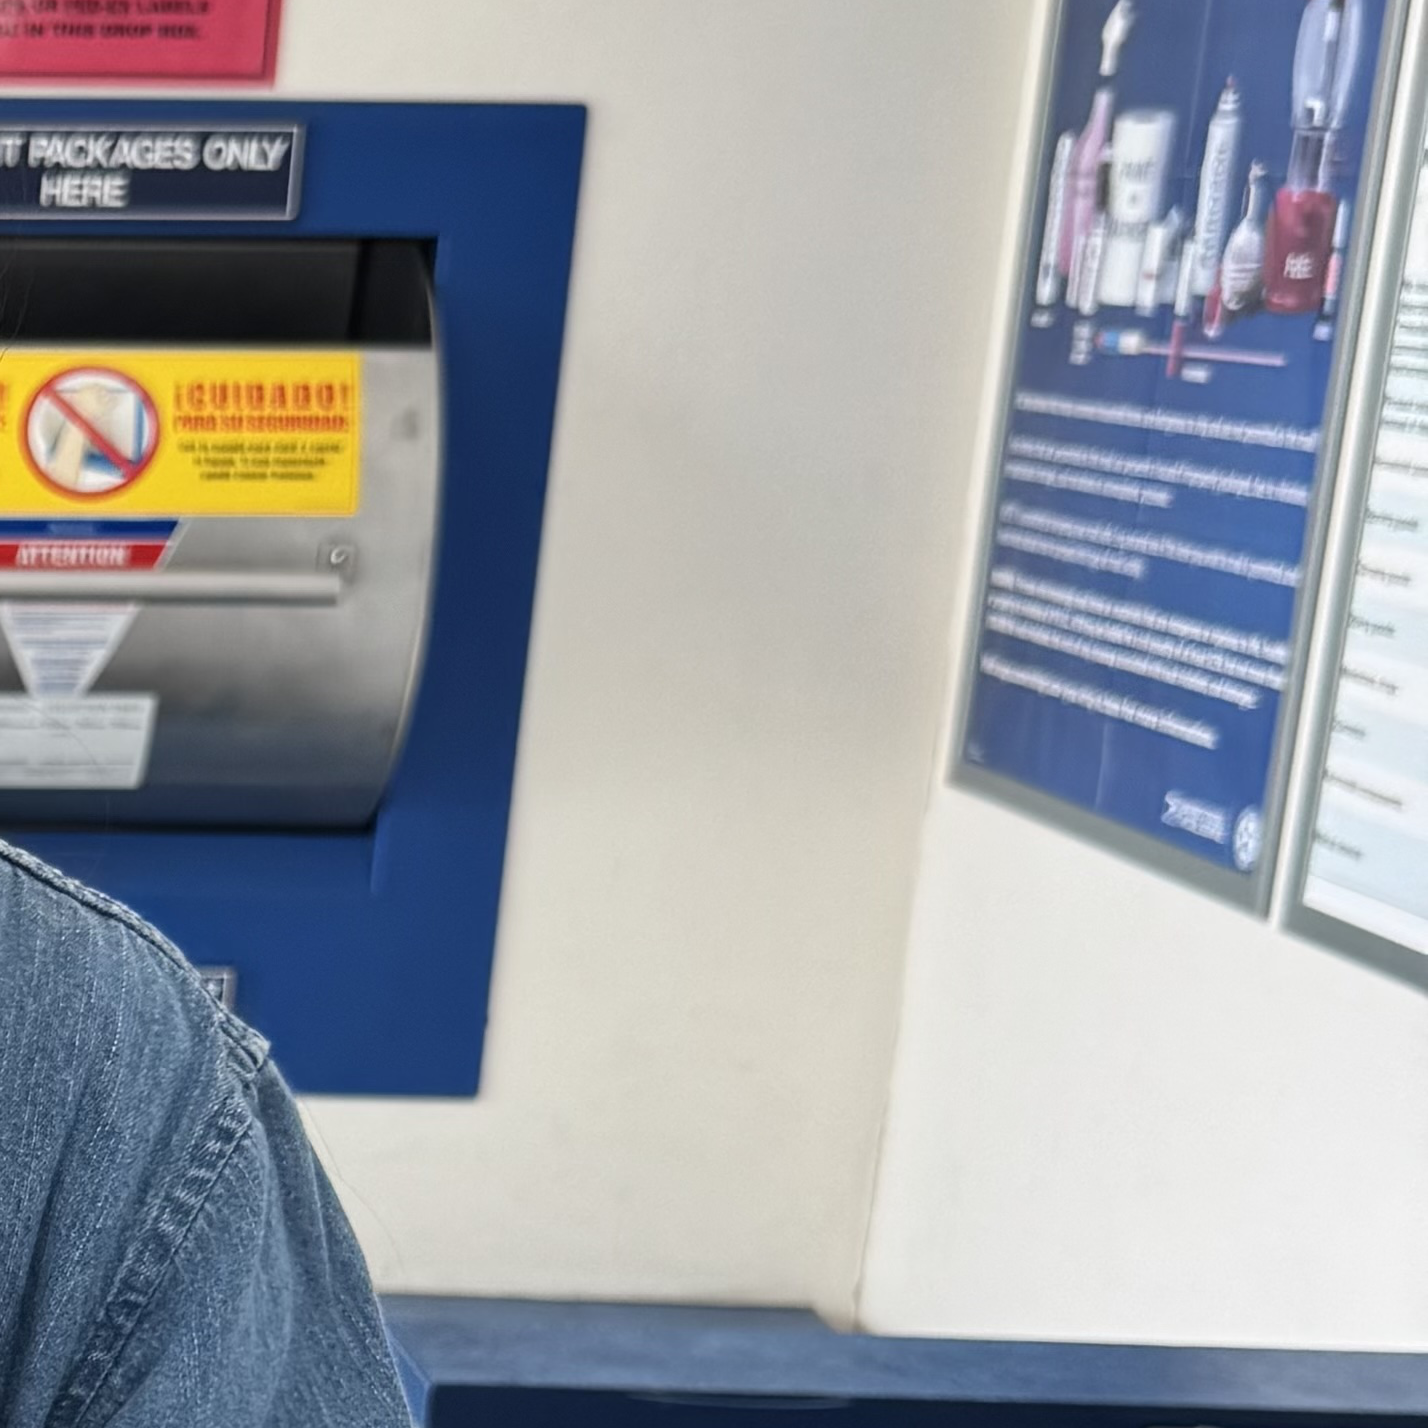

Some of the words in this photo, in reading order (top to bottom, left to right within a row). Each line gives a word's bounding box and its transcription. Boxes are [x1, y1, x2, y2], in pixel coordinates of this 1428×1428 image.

[27, 133, 200, 170] PACKAGES
[202, 134, 291, 171] ONLY
[38, 172, 131, 209] HERE
[17, 543, 129, 567] ATTENTION
